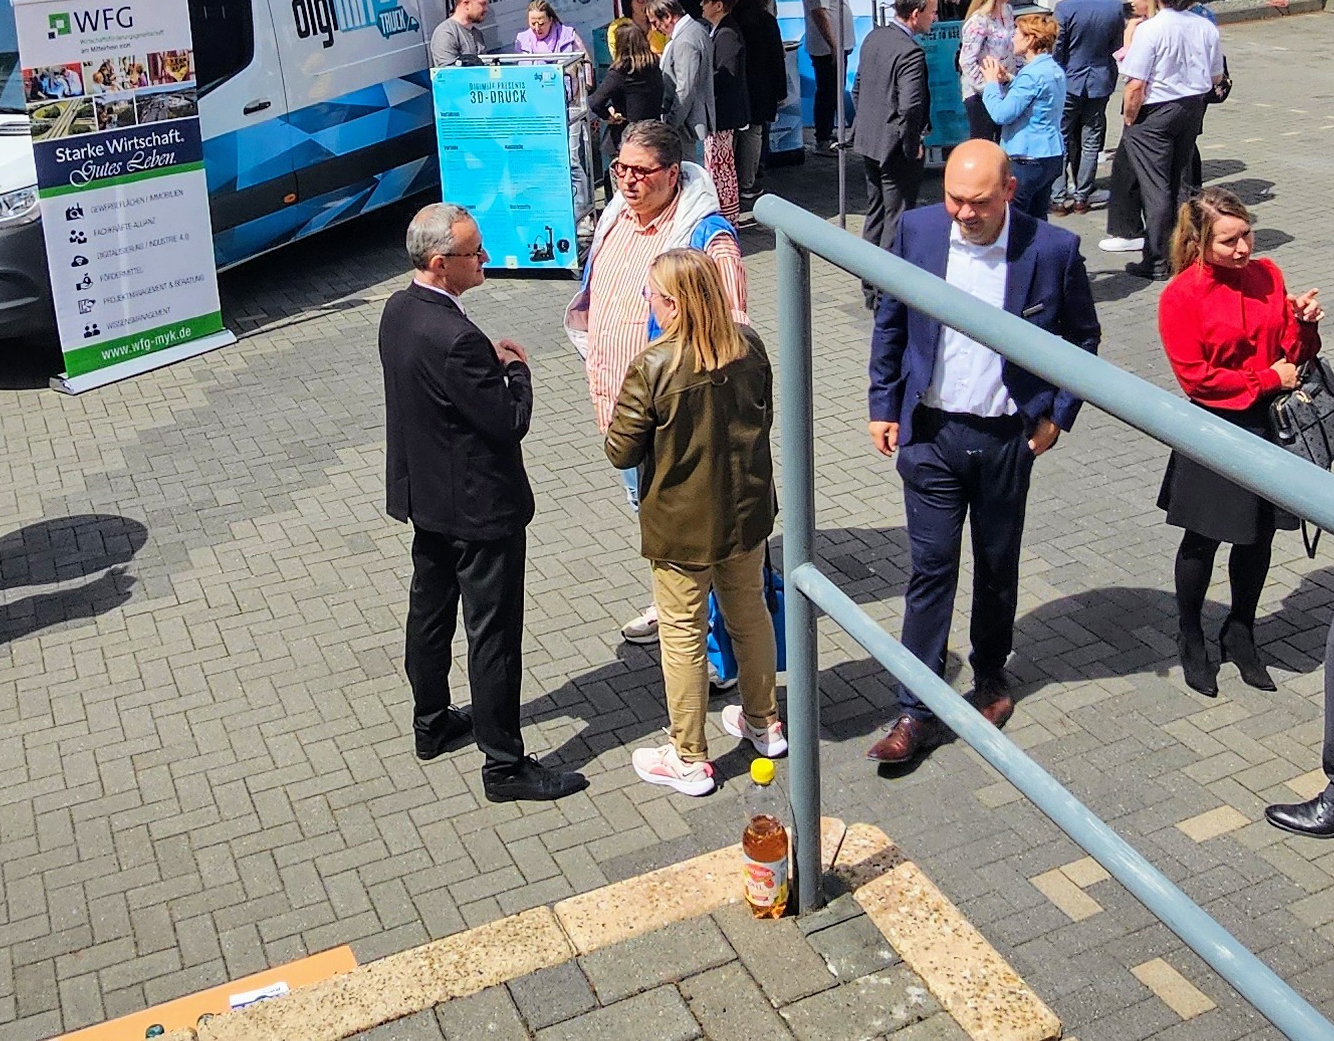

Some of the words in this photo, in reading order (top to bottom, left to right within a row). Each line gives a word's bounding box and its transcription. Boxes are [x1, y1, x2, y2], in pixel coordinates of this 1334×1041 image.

[73, 6, 134, 34] WFG
[379, 9, 408, 35] TRUCK
[470, 90, 527, 104] 3D-DRUCK
[55, 143, 104, 163] Starke
[106, 129, 185, 155] Wirtschaft.
[69, 159, 123, 188] Gutes
[126, 150, 177, 172] Leben.
[101, 326, 192, 360] www.wfg-myk.de
